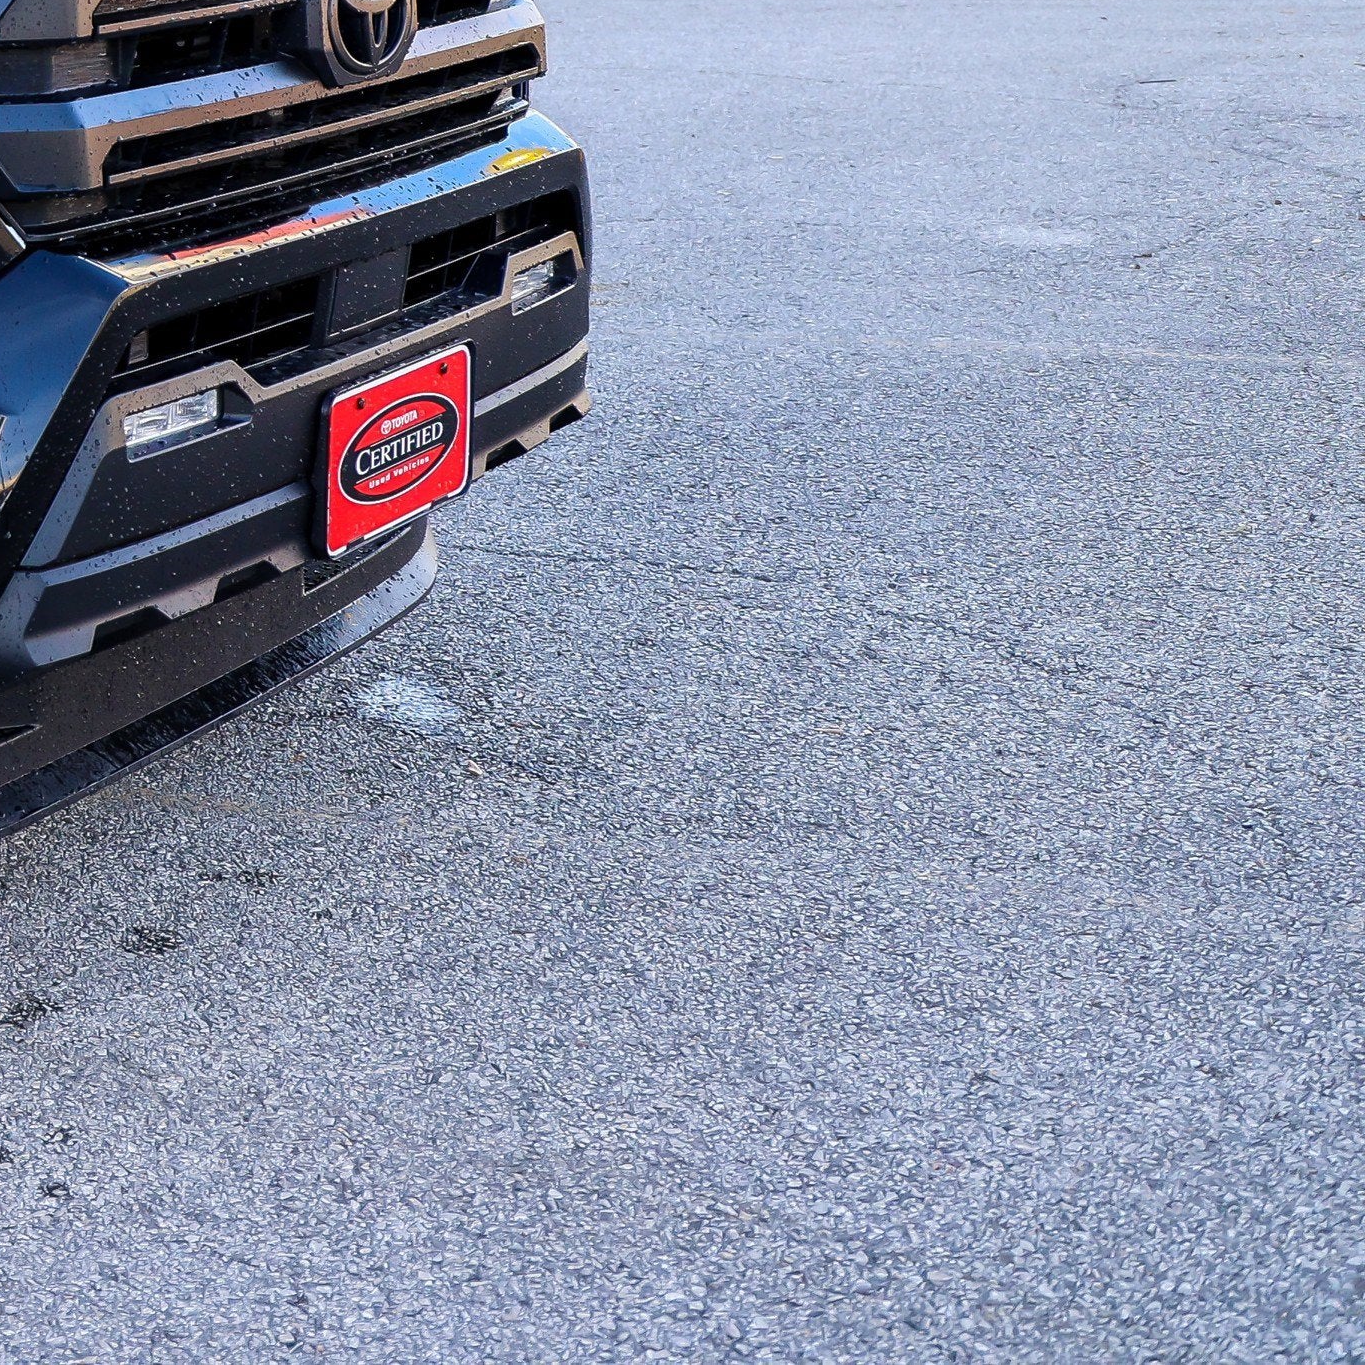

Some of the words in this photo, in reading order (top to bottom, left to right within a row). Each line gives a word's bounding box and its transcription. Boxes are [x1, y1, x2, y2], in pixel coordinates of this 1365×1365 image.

[391, 410, 418, 429] TOYOTA
[355, 421, 444, 475] CERTIFIED
[369, 473, 391, 489] Used
[393, 456, 430, 477] Vehicles
